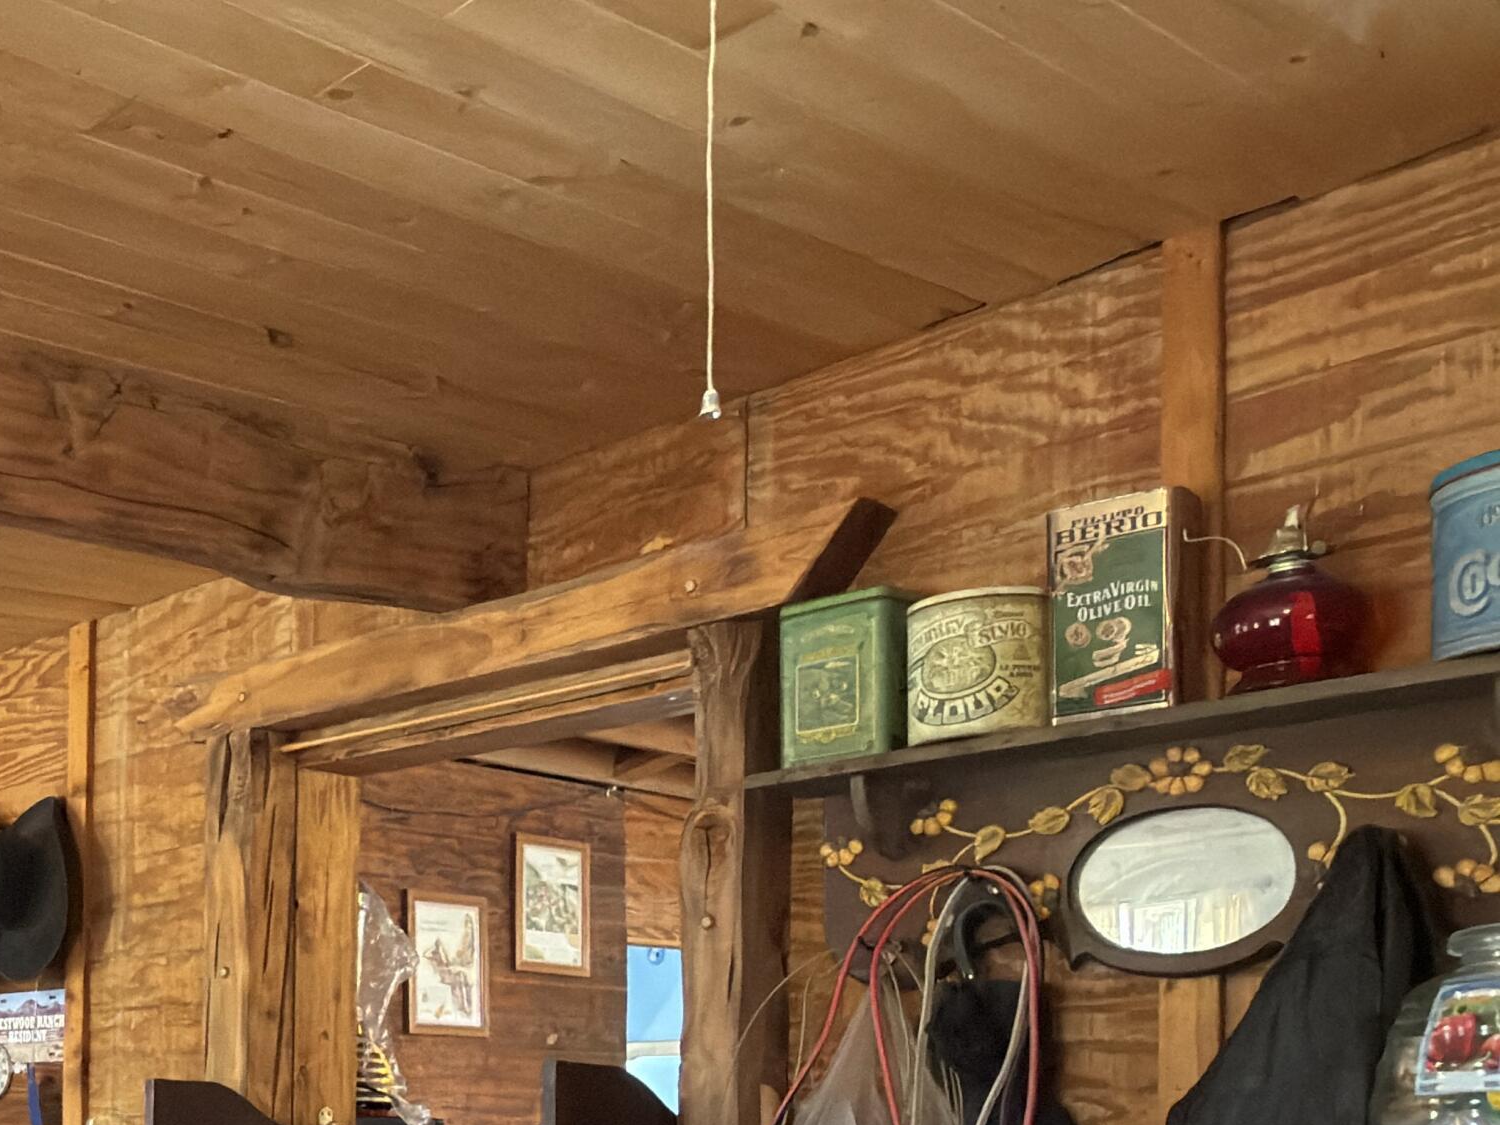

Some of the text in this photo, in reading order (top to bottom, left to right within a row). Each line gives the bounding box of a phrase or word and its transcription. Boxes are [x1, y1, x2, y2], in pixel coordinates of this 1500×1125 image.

[1055, 511, 1163, 546] BERIO
[1076, 594, 1152, 623] OLIVE OIL
